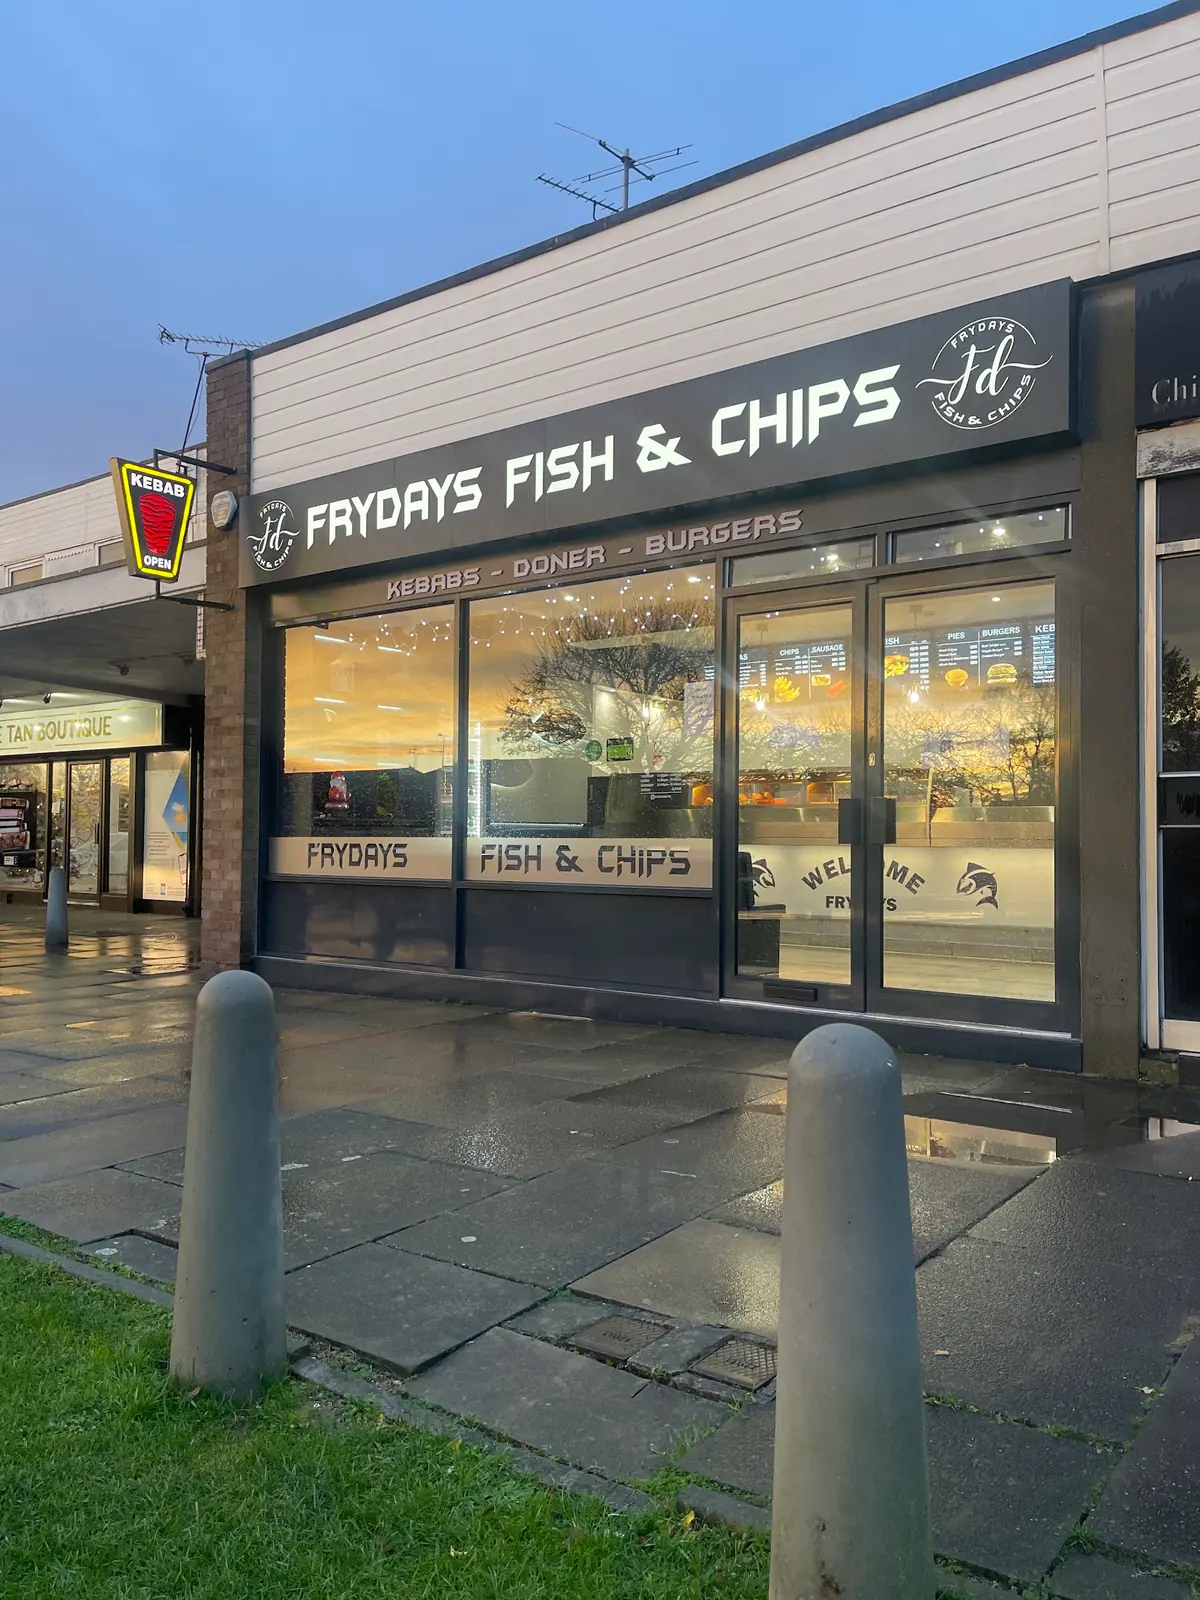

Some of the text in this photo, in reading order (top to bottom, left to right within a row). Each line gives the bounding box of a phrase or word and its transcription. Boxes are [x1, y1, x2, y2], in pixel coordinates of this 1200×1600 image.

[951, 321, 1016, 349] FRYDAYS
[934, 374, 1032, 426] FISH & CHIPS
[1151, 374, 1197, 405] Chi
[306, 466, 483, 550] FRYDAYS
[506, 435, 614, 508] FISH
[636, 423, 692, 473] &
[711, 364, 901, 458] CHIPS
[131, 472, 185, 498] KEBAB
[143, 554, 172, 570] OPEN
[387, 566, 481, 600] KEBABS
[513, 545, 606, 578] DONER
[645, 509, 804, 556] BURGERS
[947, 631, 966, 641] PIES
[982, 626, 1021, 637] BURGERS
[780, 648, 800, 657] CHIPS
[811, 643, 844, 654] SAUSAGE
[7, 724, 33, 744] TAN
[308, 843, 408, 871] FRYDAYS
[481, 844, 692, 878] FISH & CHIPS
[801, 856, 926, 895] WELME
